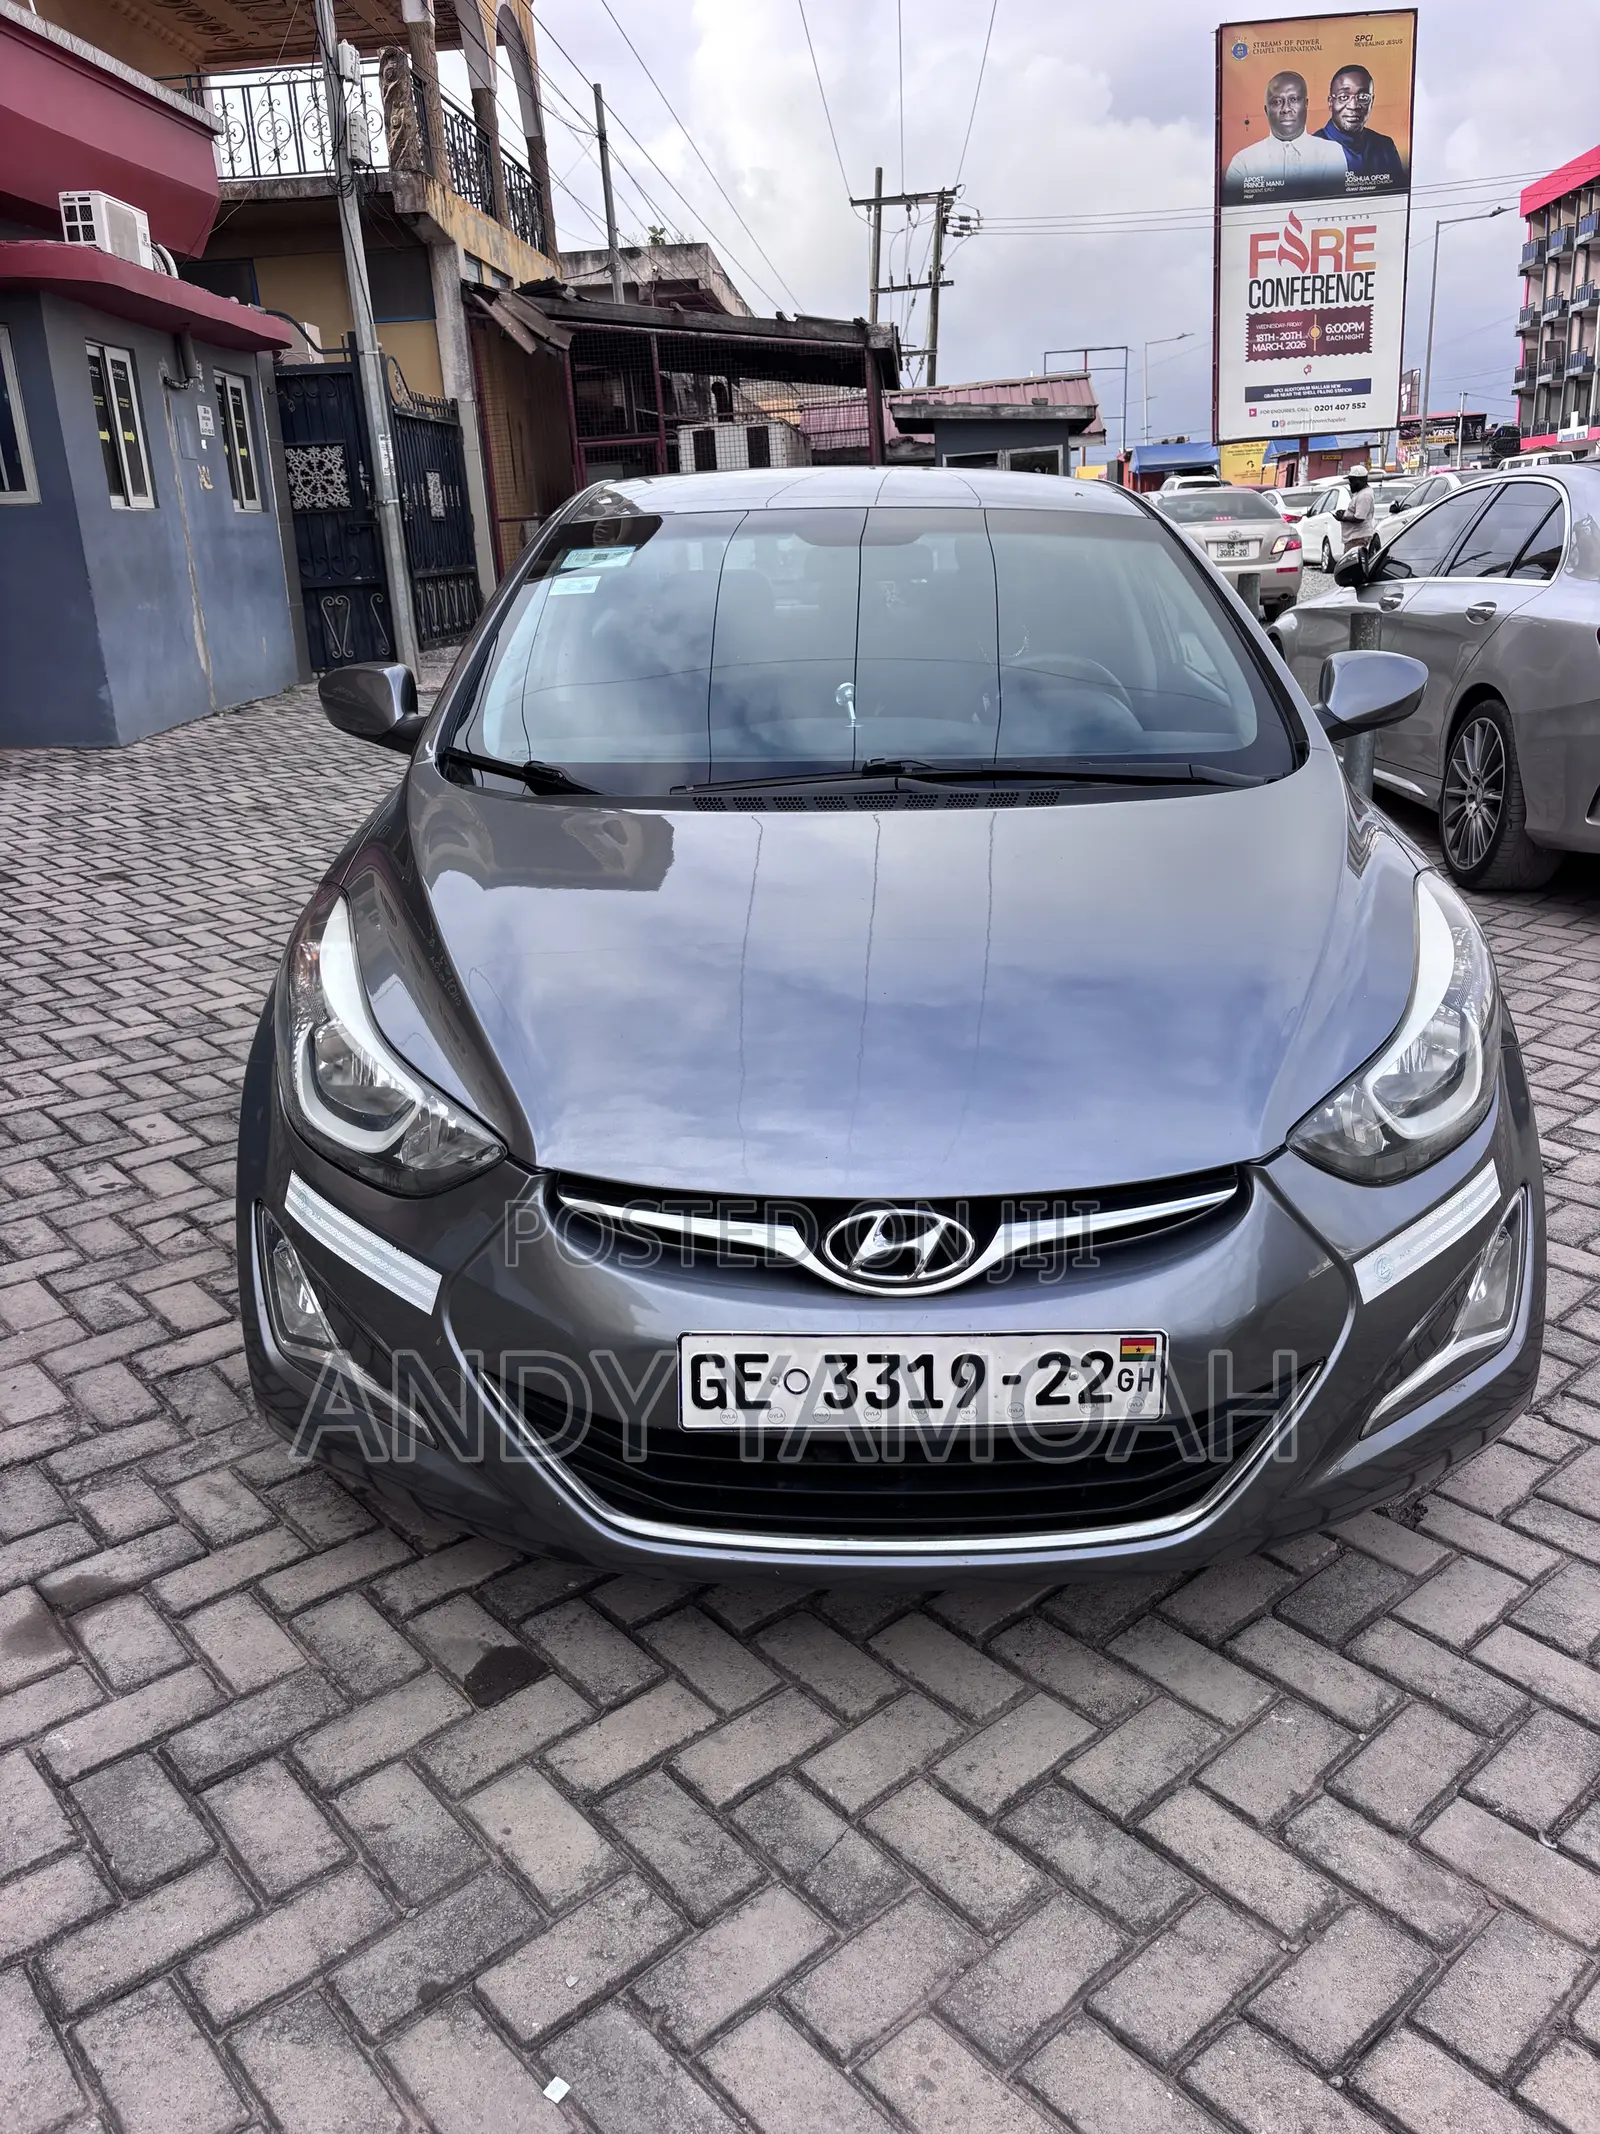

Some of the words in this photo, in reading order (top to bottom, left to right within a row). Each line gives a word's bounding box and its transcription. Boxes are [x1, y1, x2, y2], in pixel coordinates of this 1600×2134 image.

[1317, 214, 1370, 222] PRESENTS
[1248, 271, 1375, 309] CONFERENCE
[1325, 321, 1365, 334] 6:00PM
[1286, 340, 1307, 350] 2026
[1335, 403, 1350, 411] 407
[690, 1352, 772, 1410] GE
[1117, 1366, 1156, 1393] GH
